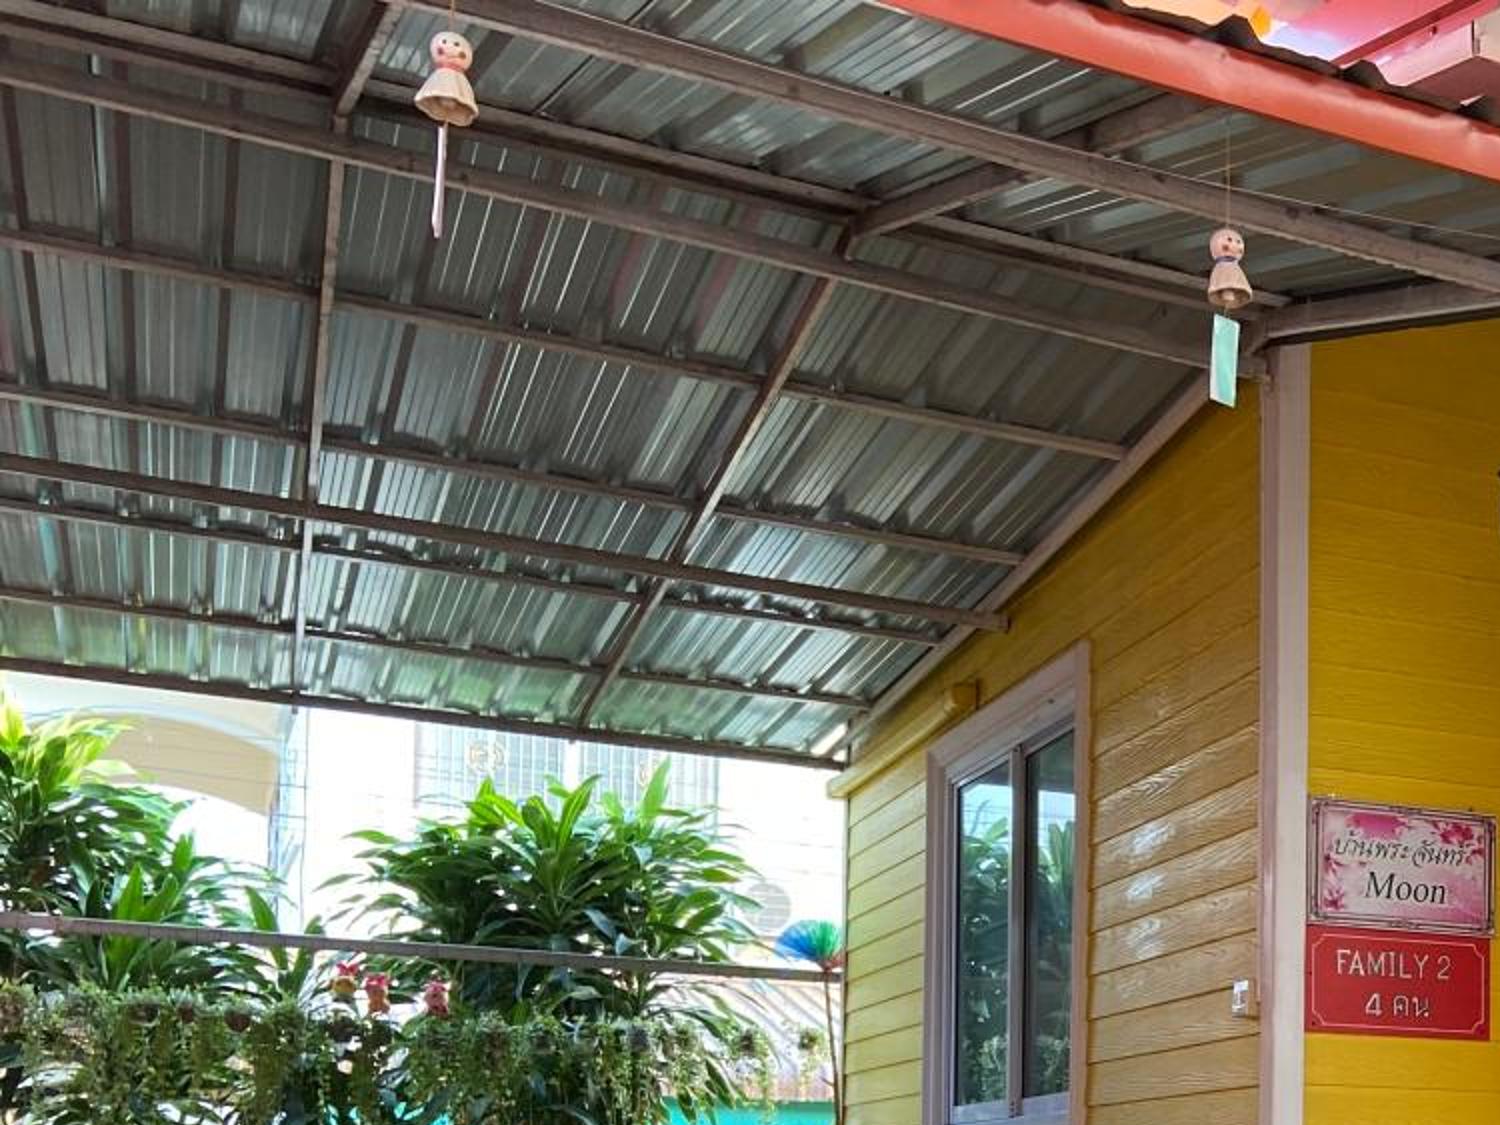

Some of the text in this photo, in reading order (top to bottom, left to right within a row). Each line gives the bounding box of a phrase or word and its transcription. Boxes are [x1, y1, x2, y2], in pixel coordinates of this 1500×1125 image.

[1366, 871, 1446, 904] Moon
[1336, 949, 1451, 980] FAMILY 2
[1365, 993, 1430, 1018] 4 คน
